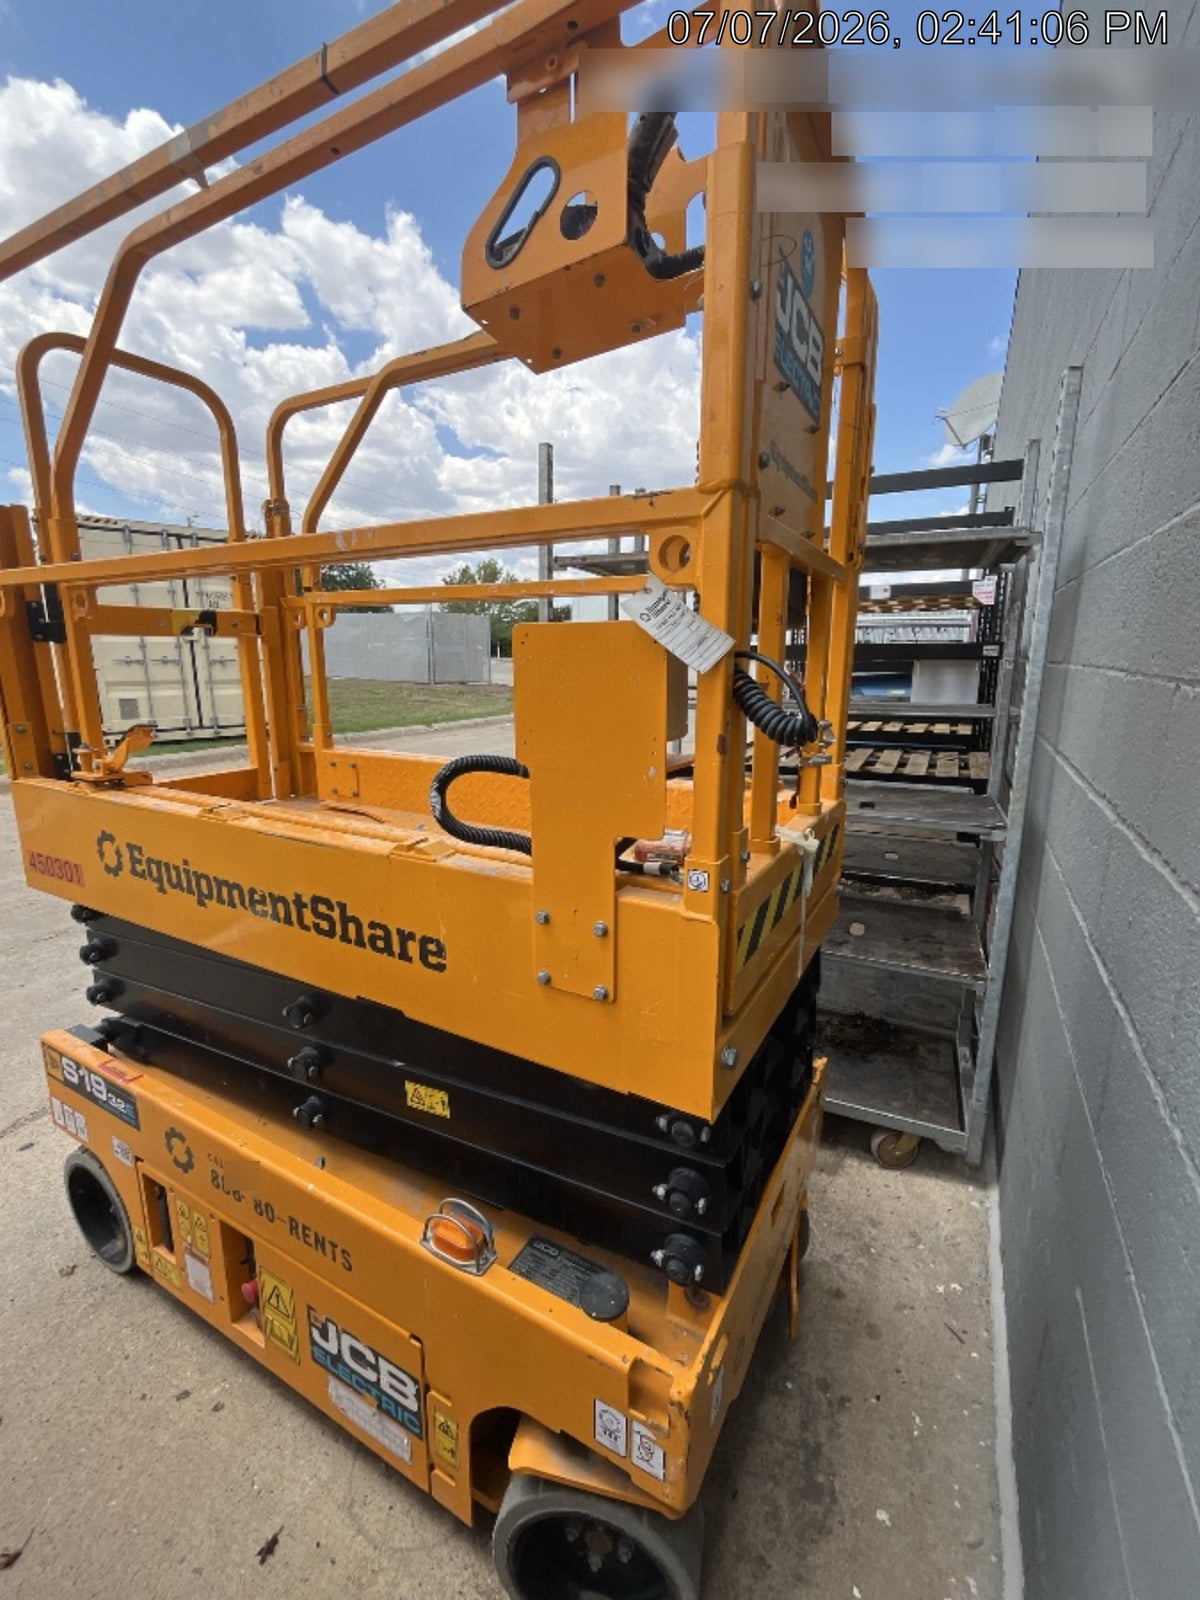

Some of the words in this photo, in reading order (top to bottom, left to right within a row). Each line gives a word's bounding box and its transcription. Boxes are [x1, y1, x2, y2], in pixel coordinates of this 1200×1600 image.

[777, 272, 824, 387] JCB
[30, 851, 81, 885] 450301
[126, 842, 447, 973] EquipmentShare
[311, 1320, 419, 1412] JCB
[313, 1346, 421, 1434] ELECTRIC
